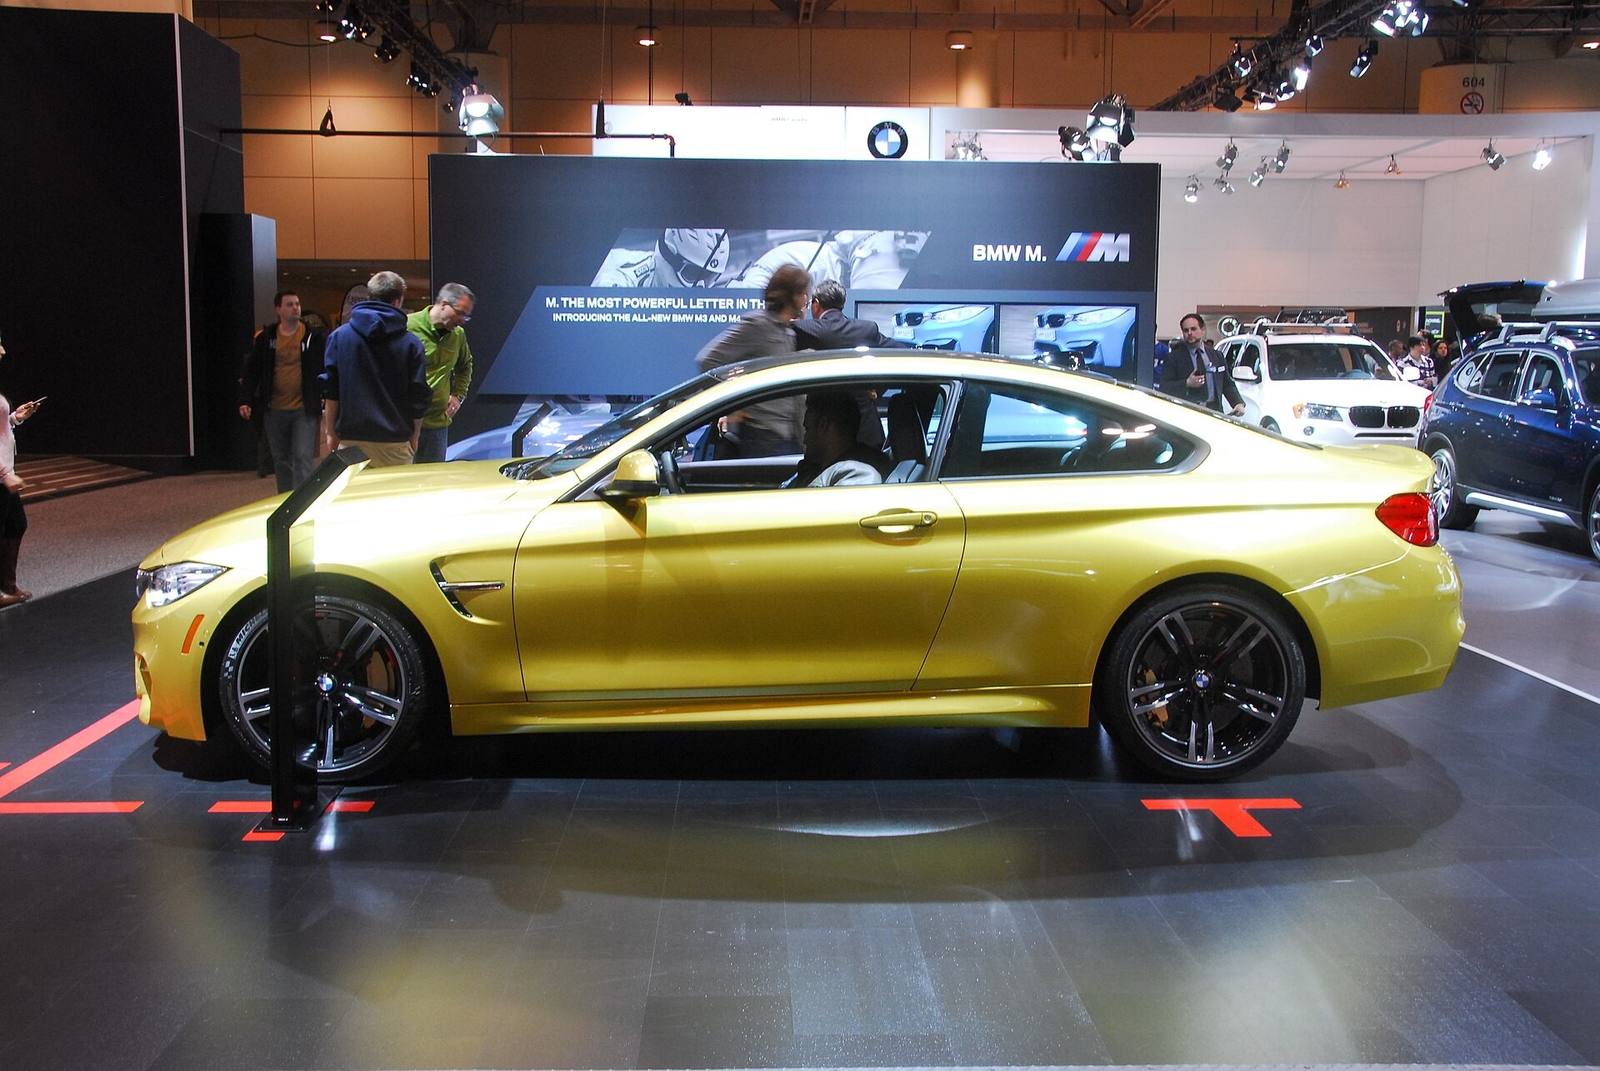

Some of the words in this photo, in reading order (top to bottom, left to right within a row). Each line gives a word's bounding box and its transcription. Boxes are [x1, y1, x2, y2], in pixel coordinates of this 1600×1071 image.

[1462, 76, 1485, 88] 604
[973, 244, 1022, 262] BMW
[1025, 245, 1047, 262] M.
[545, 297, 560, 309] M.
[560, 297, 585, 308] THE
[586, 297, 622, 309] MOST
[622, 298, 688, 309] POWERFUL
[689, 298, 735, 310] LETTER
[736, 299, 748, 310] IN
[748, 299, 766, 310] TH
[552, 313, 613, 322] INTRODUCING
[613, 313, 631, 322] THE
[631, 313, 672, 323] ALL-NEW
[672, 314, 695, 323] BMW
[694, 314, 708, 323] M3
[708, 314, 728, 323] AND
